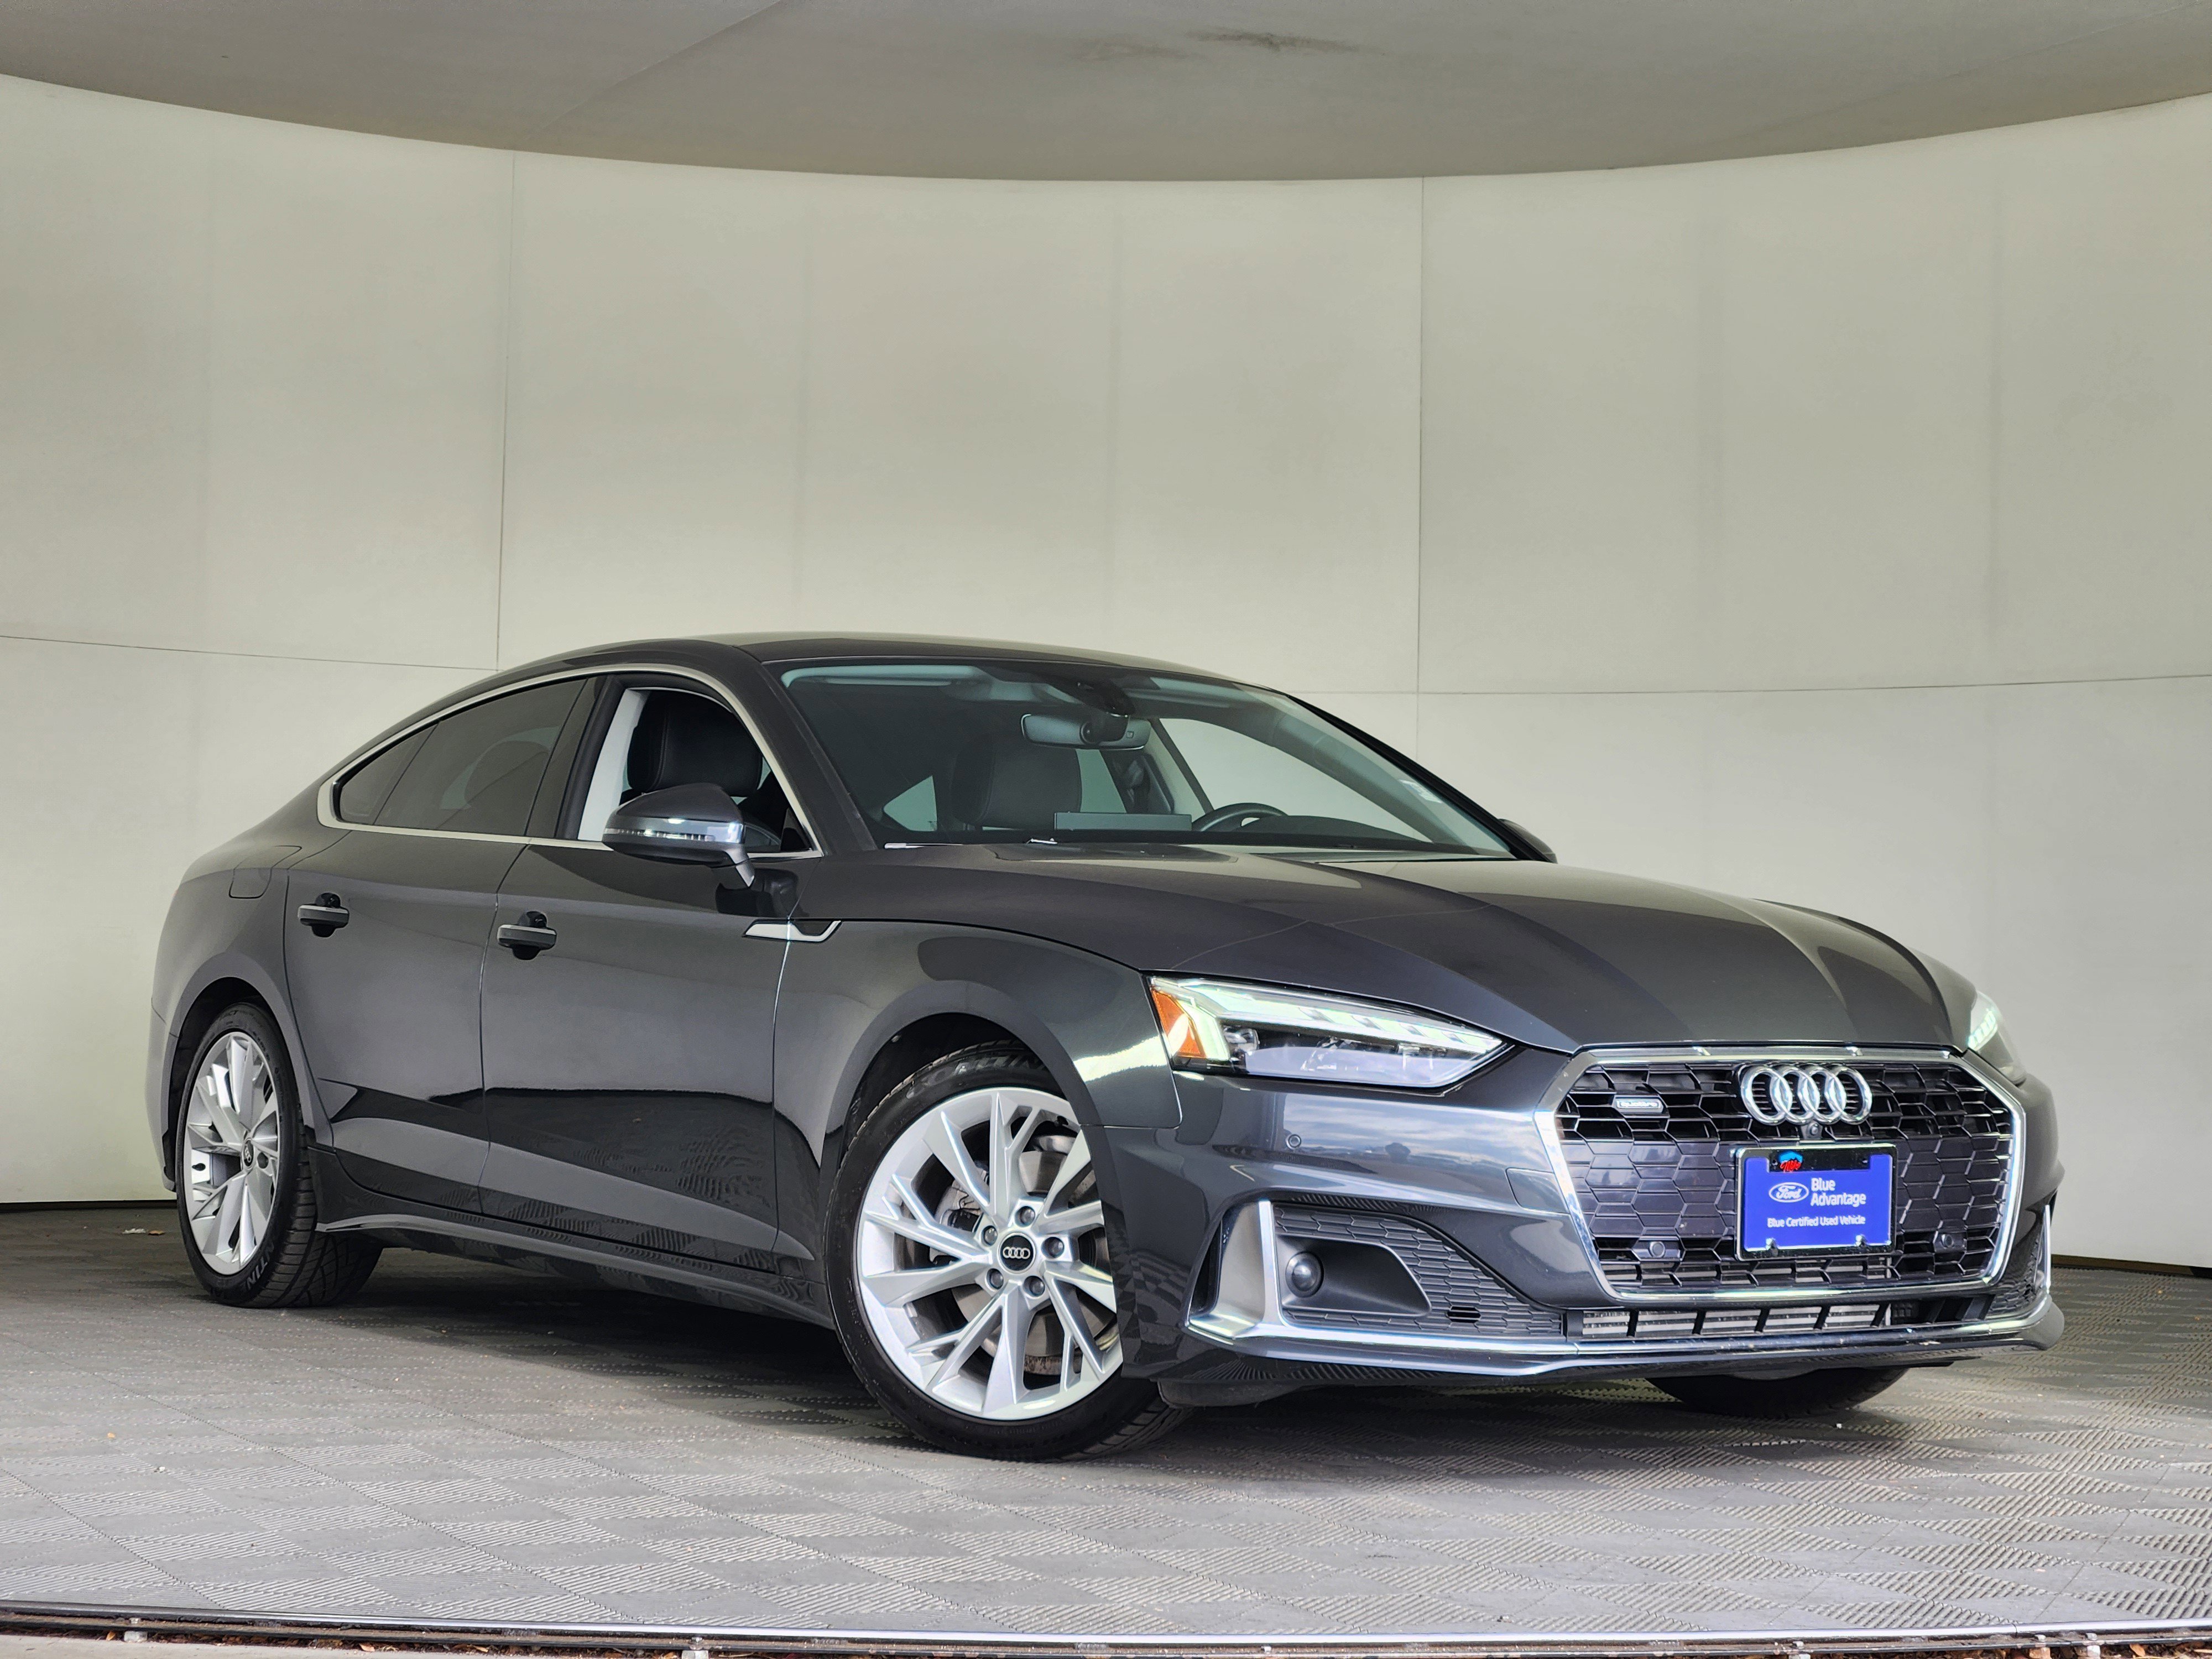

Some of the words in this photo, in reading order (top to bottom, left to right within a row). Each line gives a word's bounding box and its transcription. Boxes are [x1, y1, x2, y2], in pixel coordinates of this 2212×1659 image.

[1811, 1177, 1836, 1191] Blue
[1776, 1185, 1803, 1199] Ford
[1810, 1192, 1866, 1207] Advantage
[1767, 1217, 1785, 1228] Blue
[1786, 1216, 1819, 1227] Certified
[1820, 1215, 1838, 1226] Used
[1839, 1215, 1866, 1225] Vehicle
